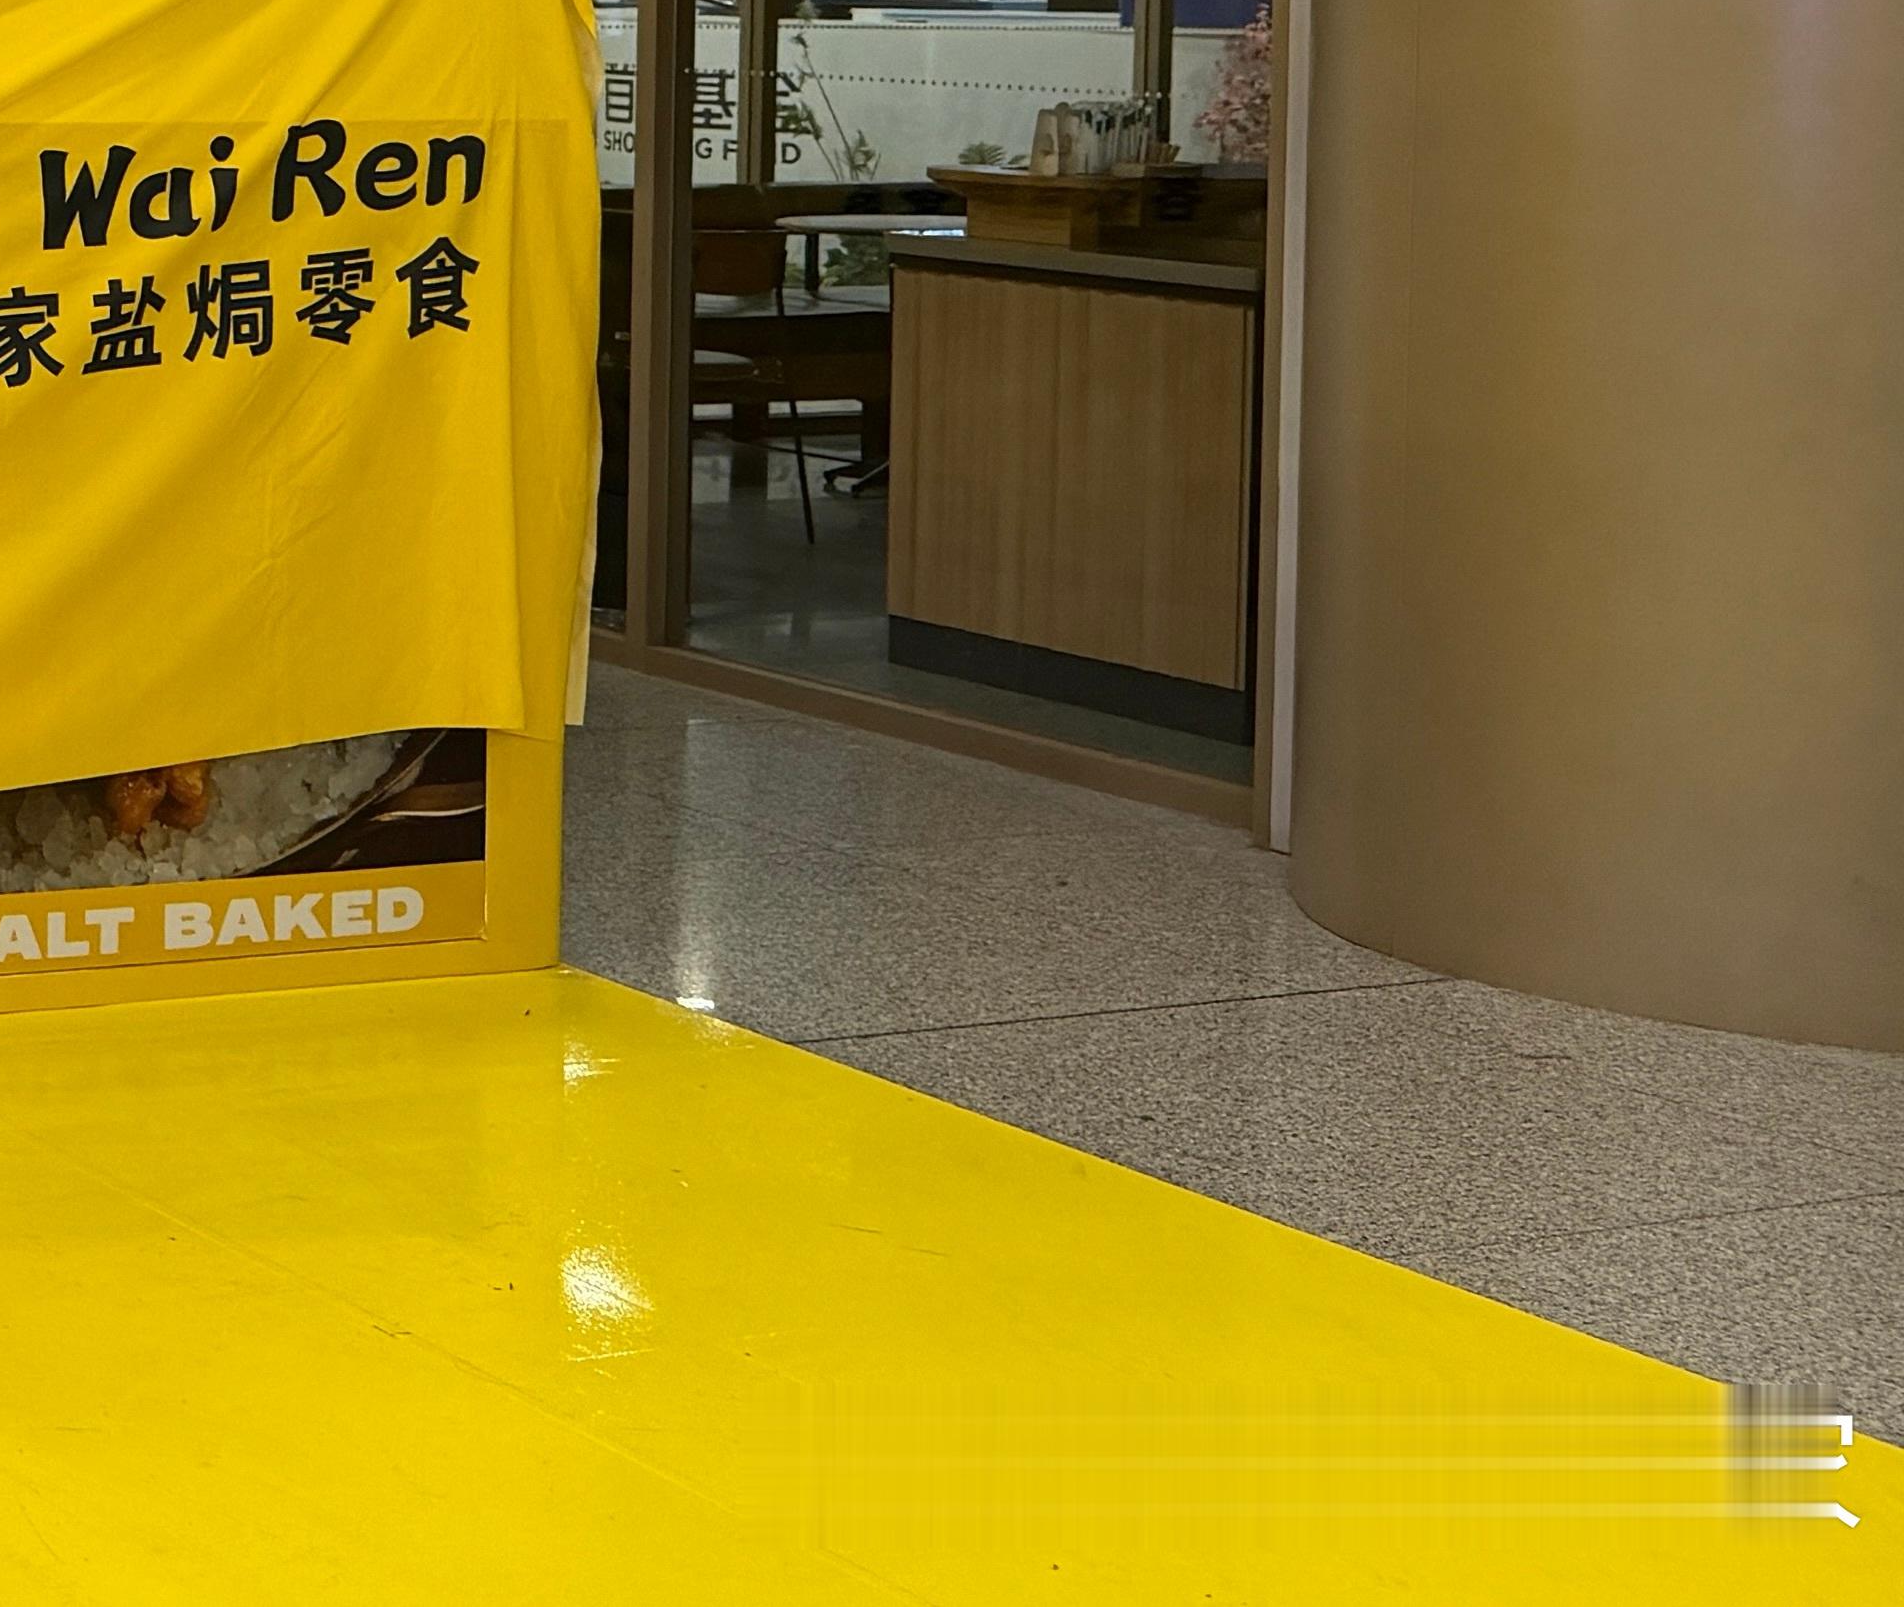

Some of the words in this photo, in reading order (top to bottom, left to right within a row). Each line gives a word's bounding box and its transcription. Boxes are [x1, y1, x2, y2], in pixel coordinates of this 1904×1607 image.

[39, 134, 240, 250] Wai
[271, 118, 487, 222] Ren
[163, 886, 424, 951] BAKED
